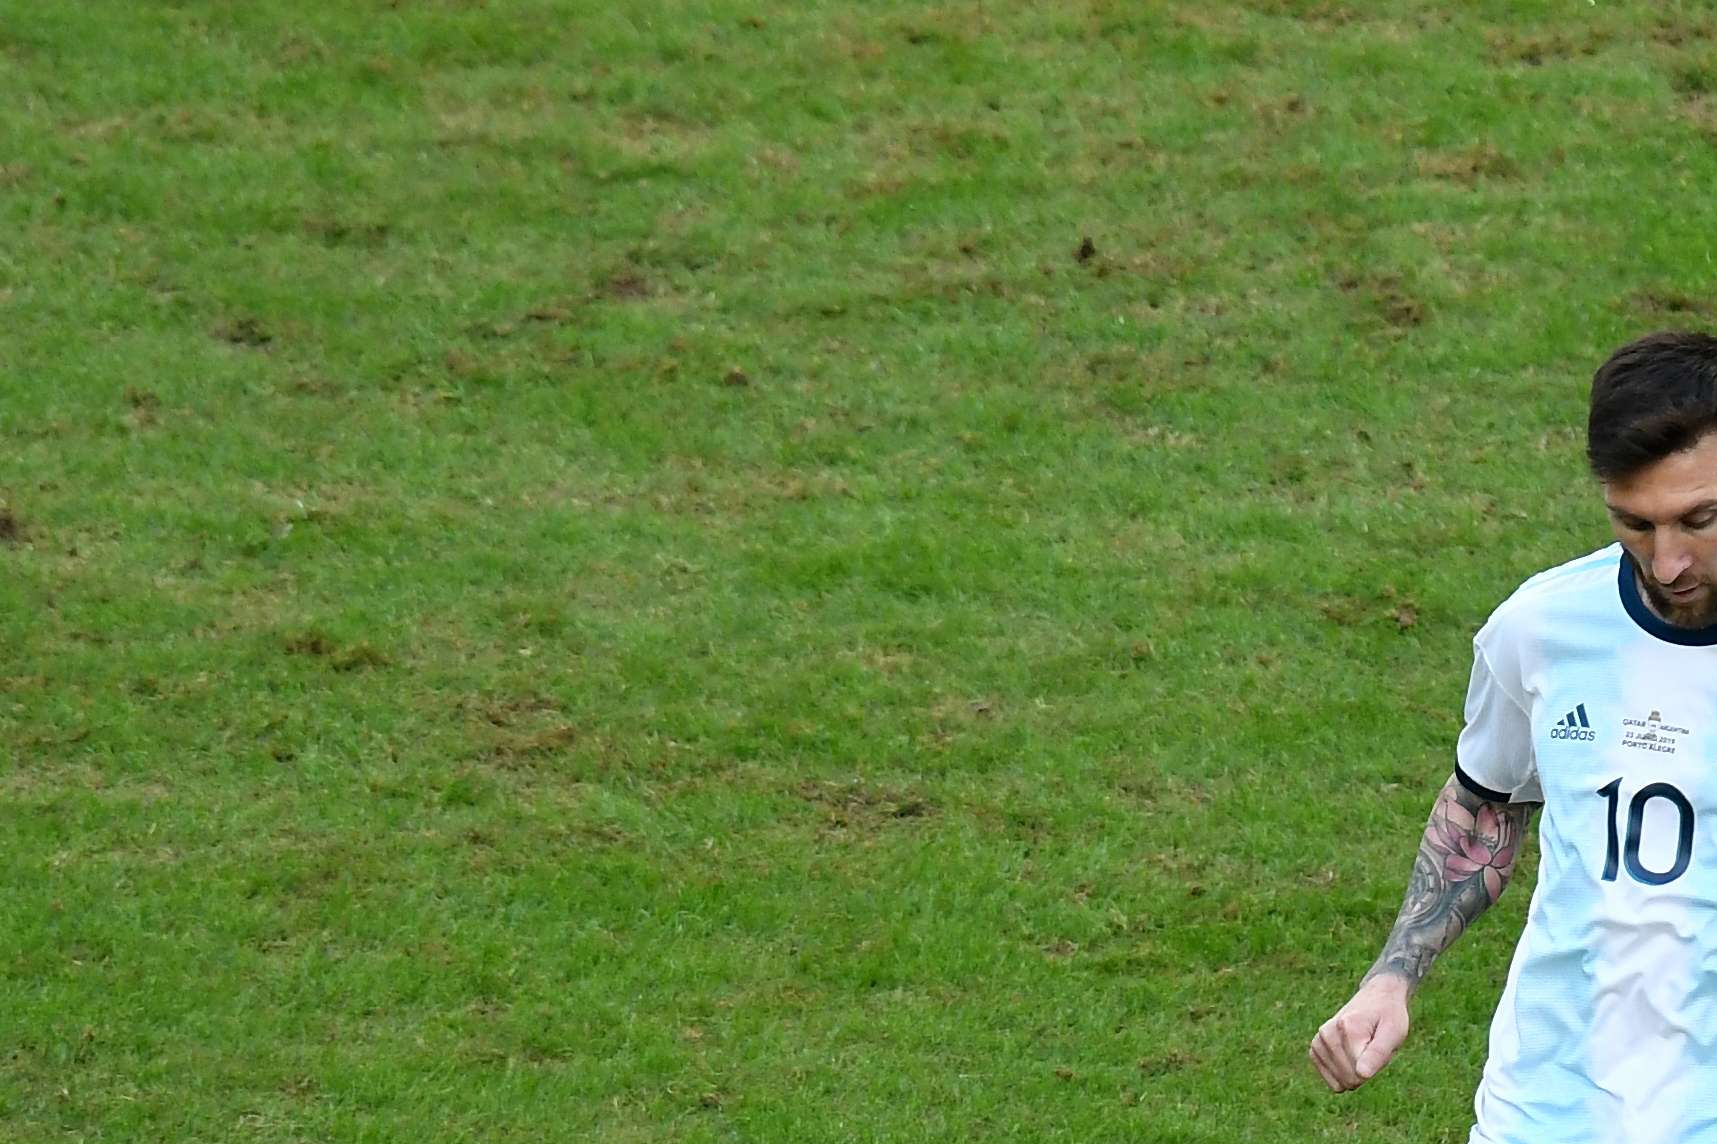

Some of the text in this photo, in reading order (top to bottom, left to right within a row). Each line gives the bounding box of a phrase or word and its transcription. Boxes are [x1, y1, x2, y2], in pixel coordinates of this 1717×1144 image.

[1622, 718, 1647, 728] QATAR
[1550, 725, 1596, 742] adidas
[1622, 740, 1648, 749] PORTO
[1596, 776, 1695, 886] 10
